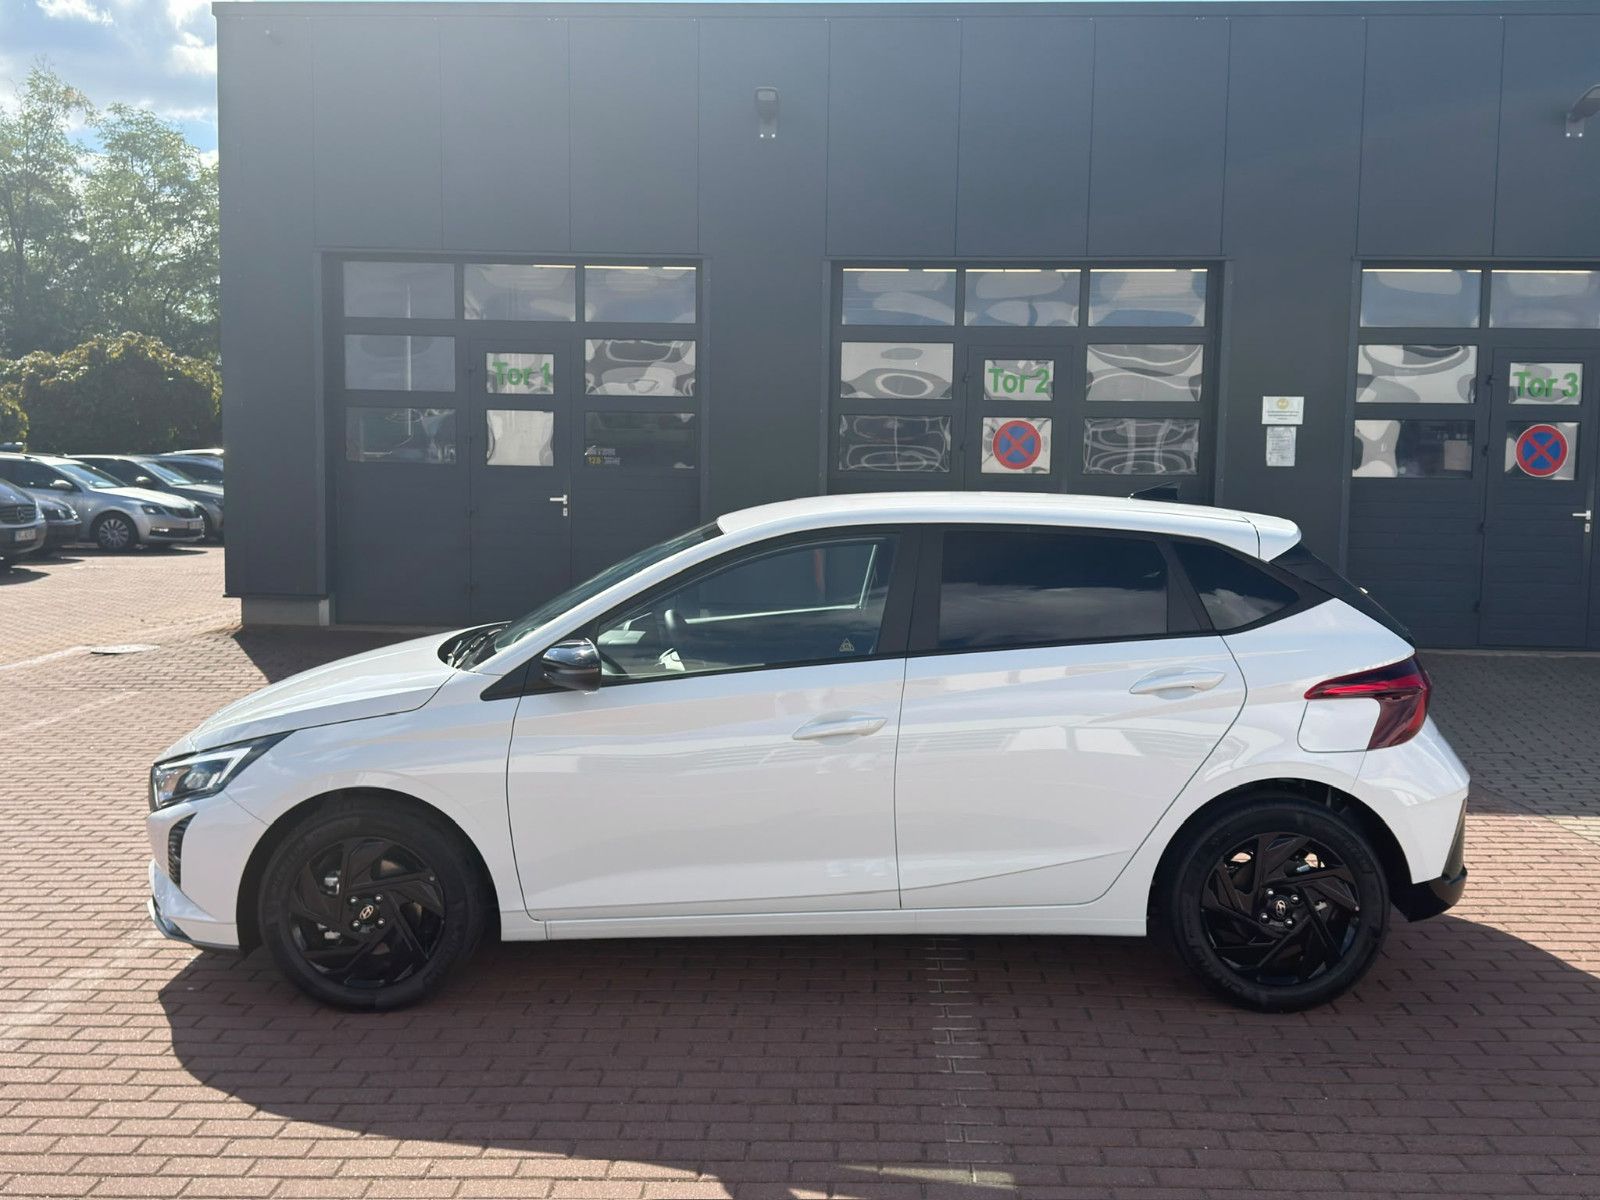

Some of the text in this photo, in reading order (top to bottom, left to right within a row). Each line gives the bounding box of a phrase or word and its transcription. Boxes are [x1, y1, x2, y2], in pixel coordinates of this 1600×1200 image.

[492, 361, 550, 385] Tor 1
[988, 368, 1050, 393] Tor 2
[1513, 371, 1578, 397] Tor 3
